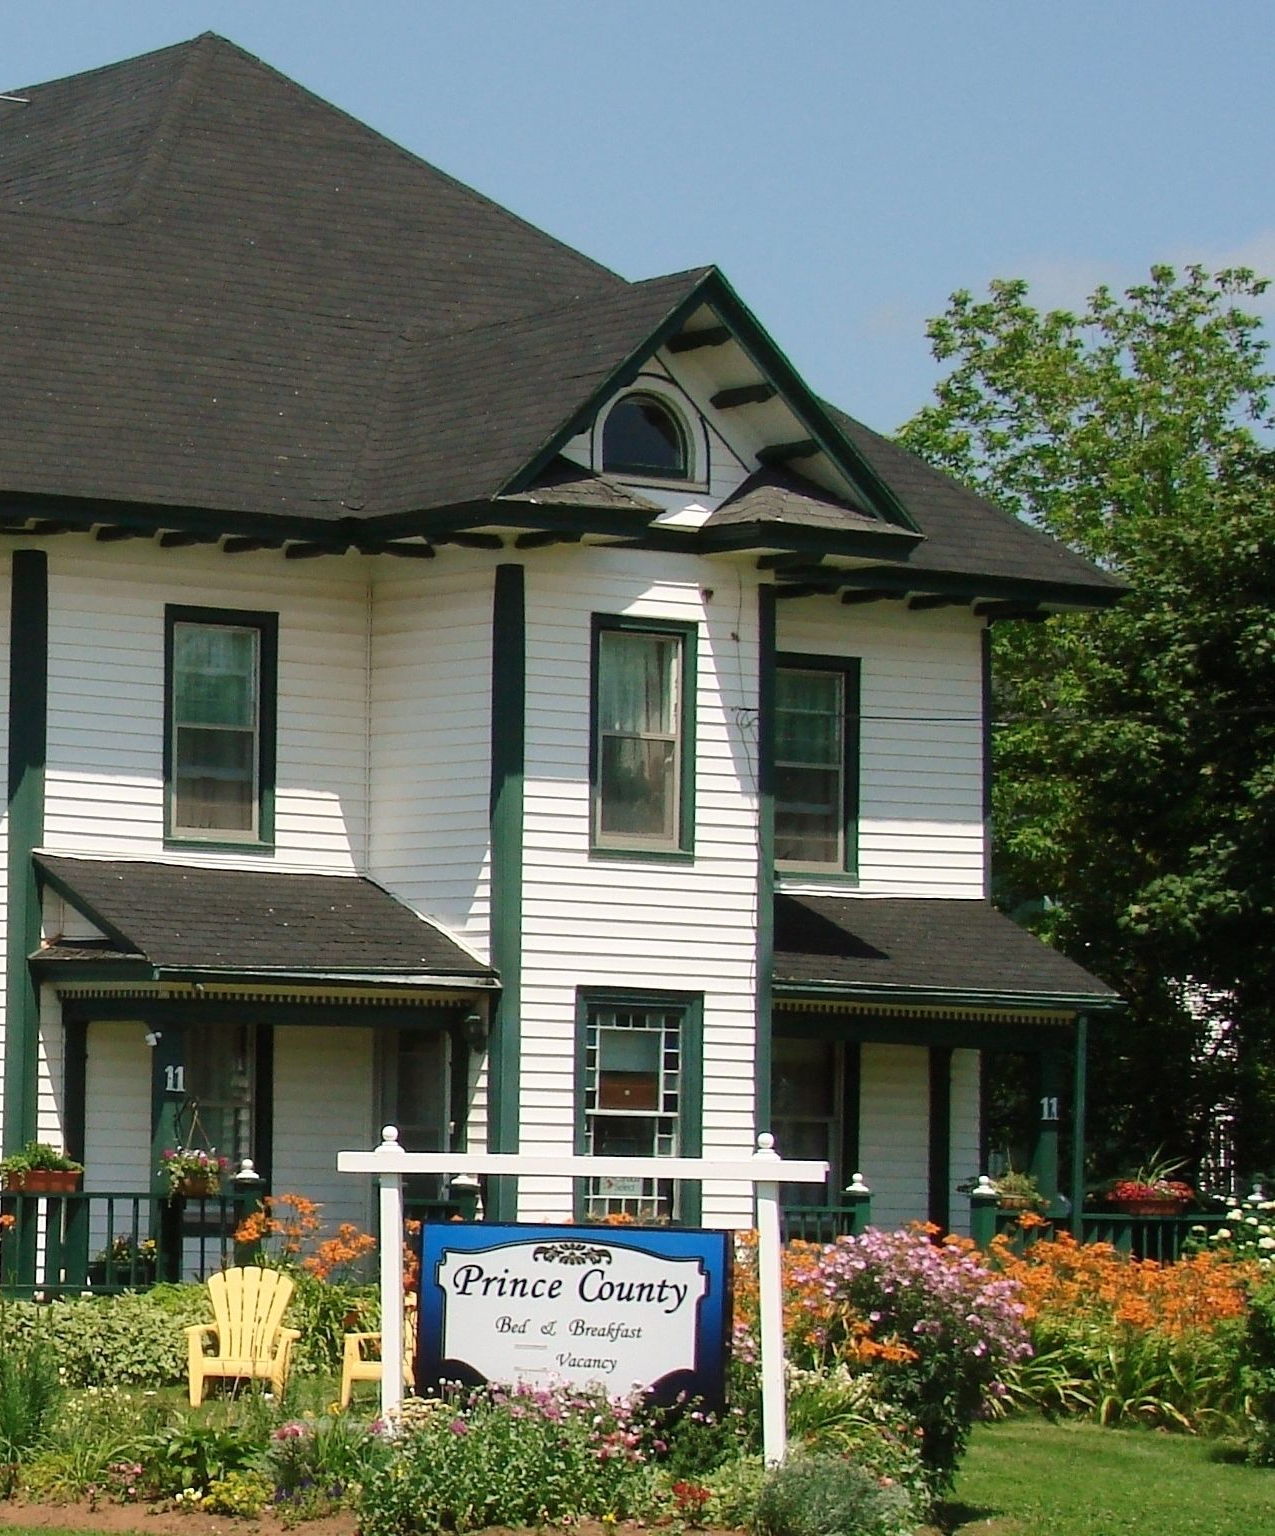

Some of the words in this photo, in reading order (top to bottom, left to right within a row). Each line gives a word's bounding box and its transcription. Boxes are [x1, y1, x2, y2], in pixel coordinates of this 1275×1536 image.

[165, 1065, 185, 1092] 11
[1040, 1097, 1059, 1120] 11
[453, 1264, 563, 1299] Prince
[578, 1268, 688, 1314] County
[495, 1316, 531, 1334] Bed
[540, 1320, 558, 1336] &
[568, 1319, 643, 1342] Breakfast
[555, 1352, 618, 1374] Vacancy
